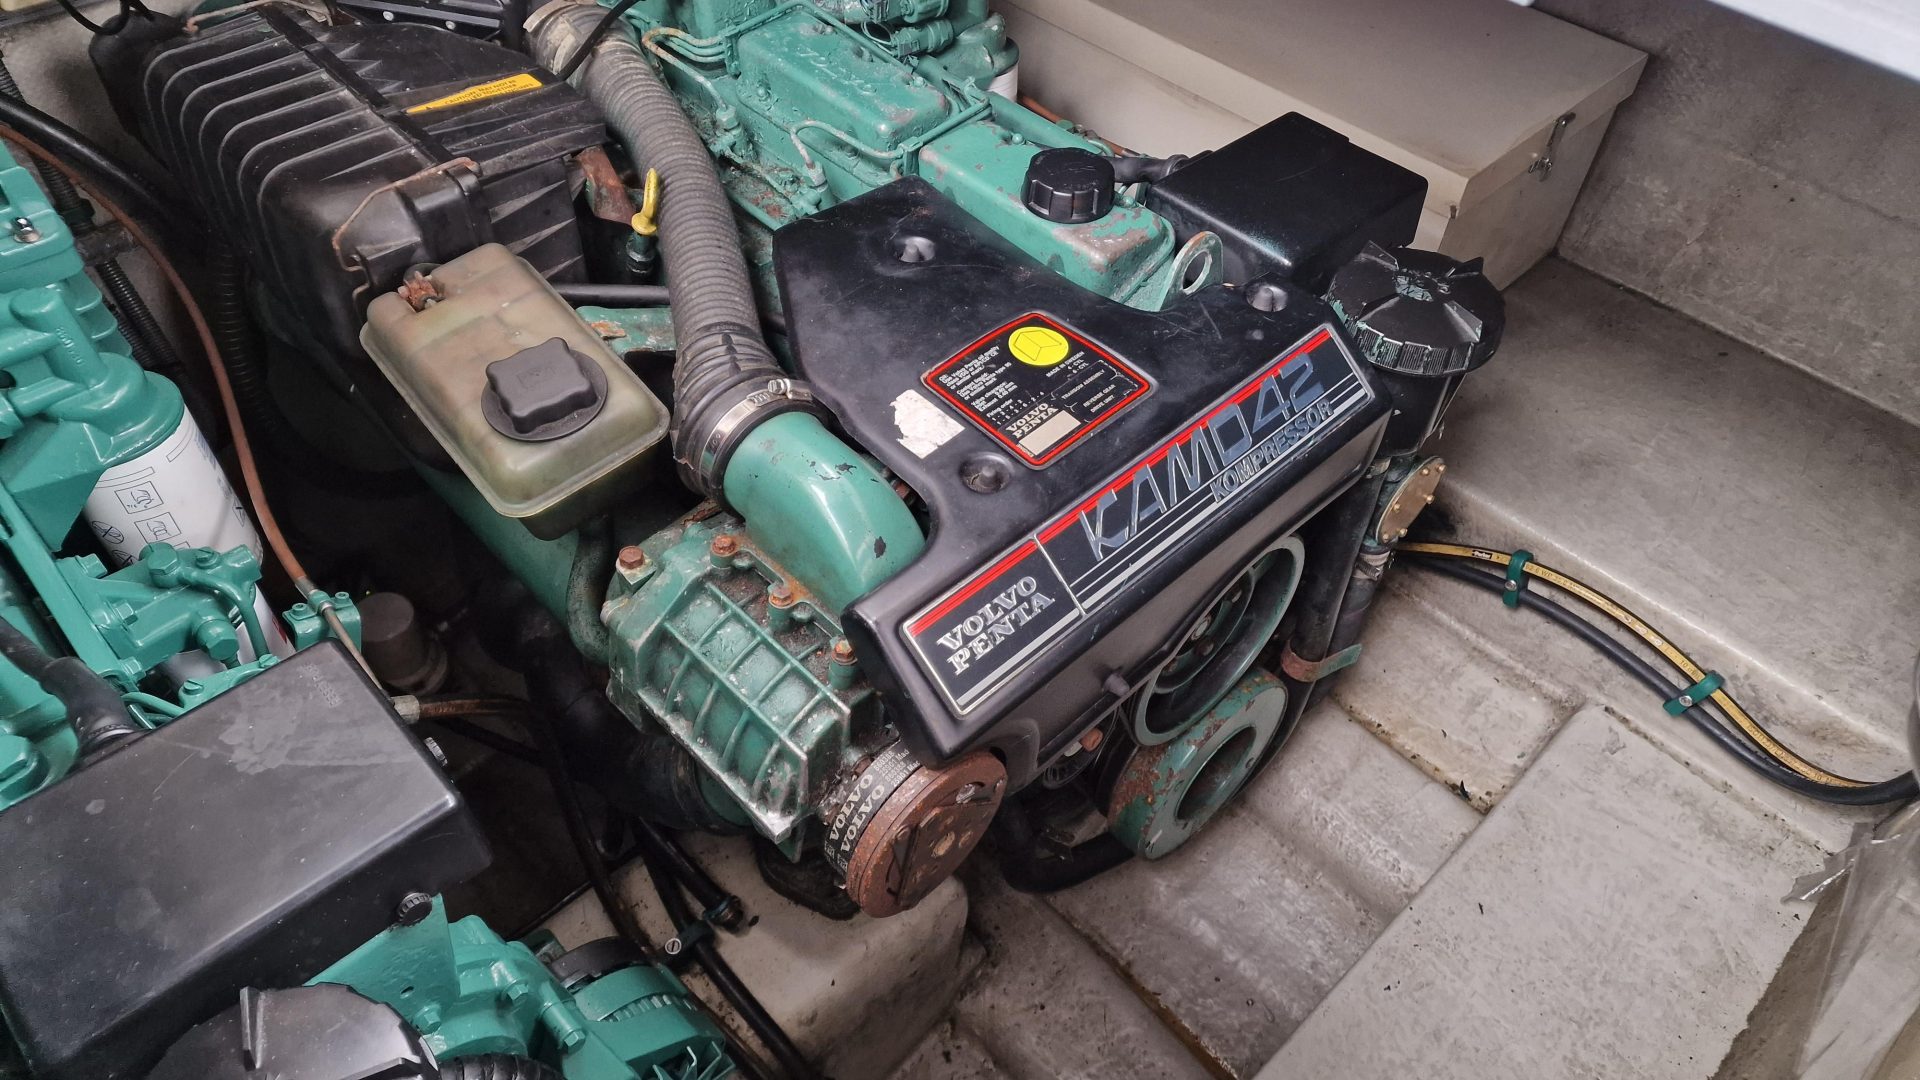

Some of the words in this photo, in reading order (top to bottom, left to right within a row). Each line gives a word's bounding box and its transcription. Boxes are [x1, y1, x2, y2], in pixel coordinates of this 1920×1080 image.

[1045, 367, 1060, 376] MADE
[1064, 351, 1084, 364] SWEDEN
[986, 407, 1001, 417] Firing
[999, 399, 1013, 407] order
[1102, 384, 1115, 392] GEAR
[1005, 403, 1049, 430] VOLVO
[1012, 407, 1058, 437] PENTA
[1210, 400, 1335, 501] KOMPRESSOR
[937, 576, 1036, 649] VOLVO
[946, 592, 1055, 675] PENTA
[830, 775, 871, 839] VOLVO
[841, 786, 883, 850] VOLVO
